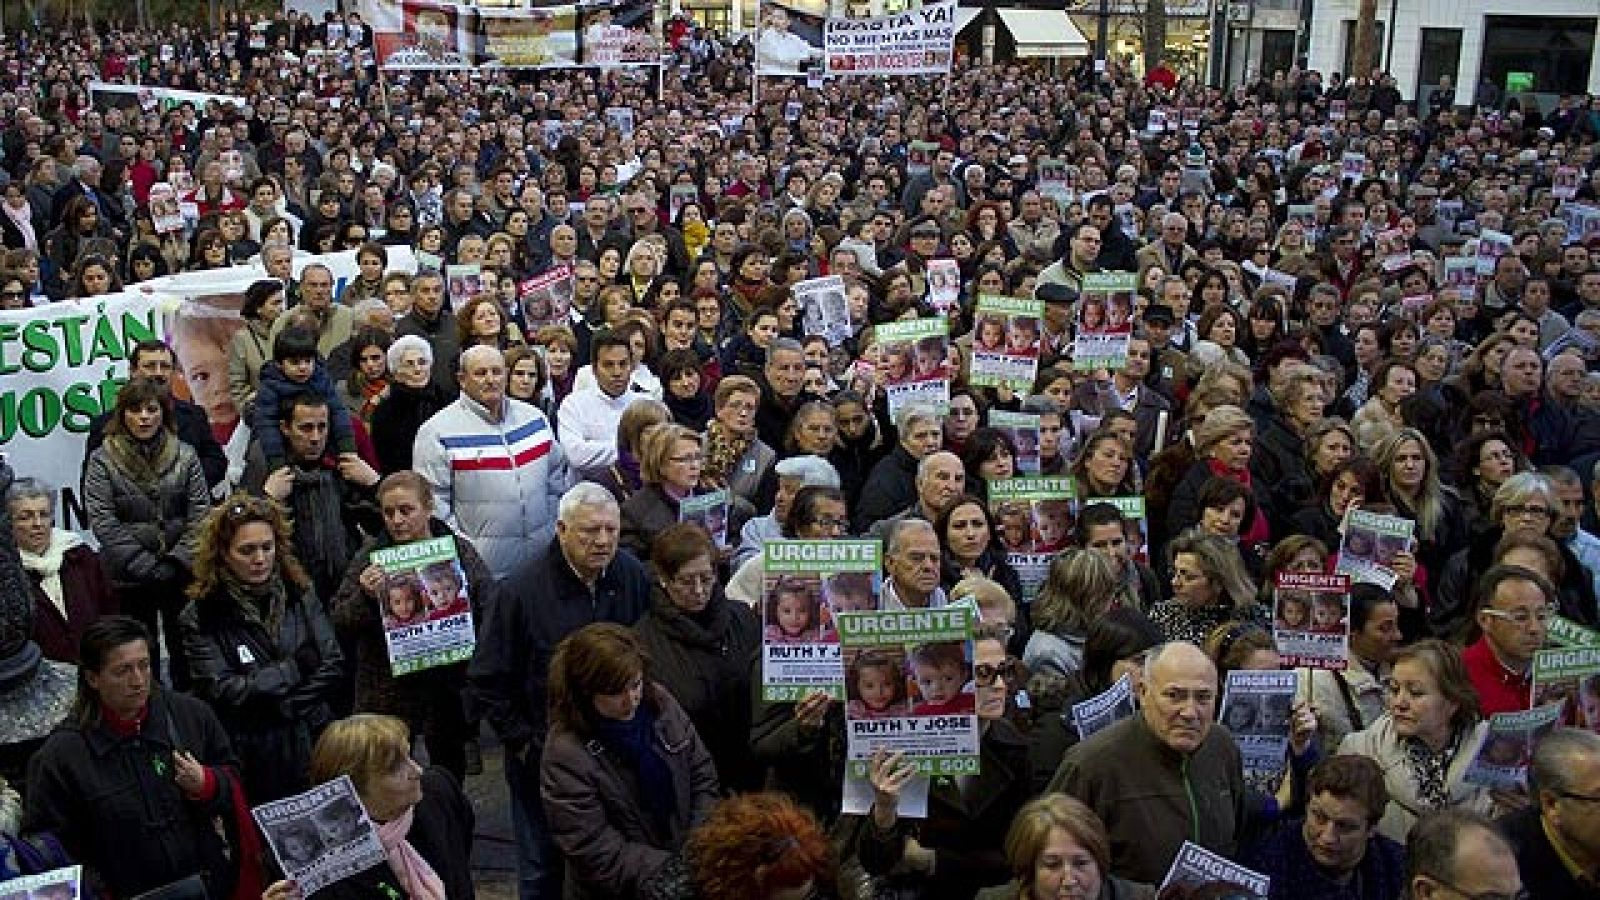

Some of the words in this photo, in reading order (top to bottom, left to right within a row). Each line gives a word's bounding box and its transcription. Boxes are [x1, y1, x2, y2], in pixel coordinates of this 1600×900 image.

[827, 35, 850, 46] NO
[990, 479, 1071, 491] URGENTE
[769, 544, 876, 561] URGENTE
[1279, 572, 1345, 586] URGENTE
[844, 611, 965, 633] URGENTE
[769, 646, 813, 658] RUTH
[819, 646, 828, 658] Y
[1540, 650, 1600, 669] URGEN
[1230, 674, 1294, 687] URGENTE
[855, 719, 901, 733] RUTH
[907, 719, 918, 731] Y
[924, 717, 971, 731] JOSE
[1186, 849, 1267, 895] URGENTE
